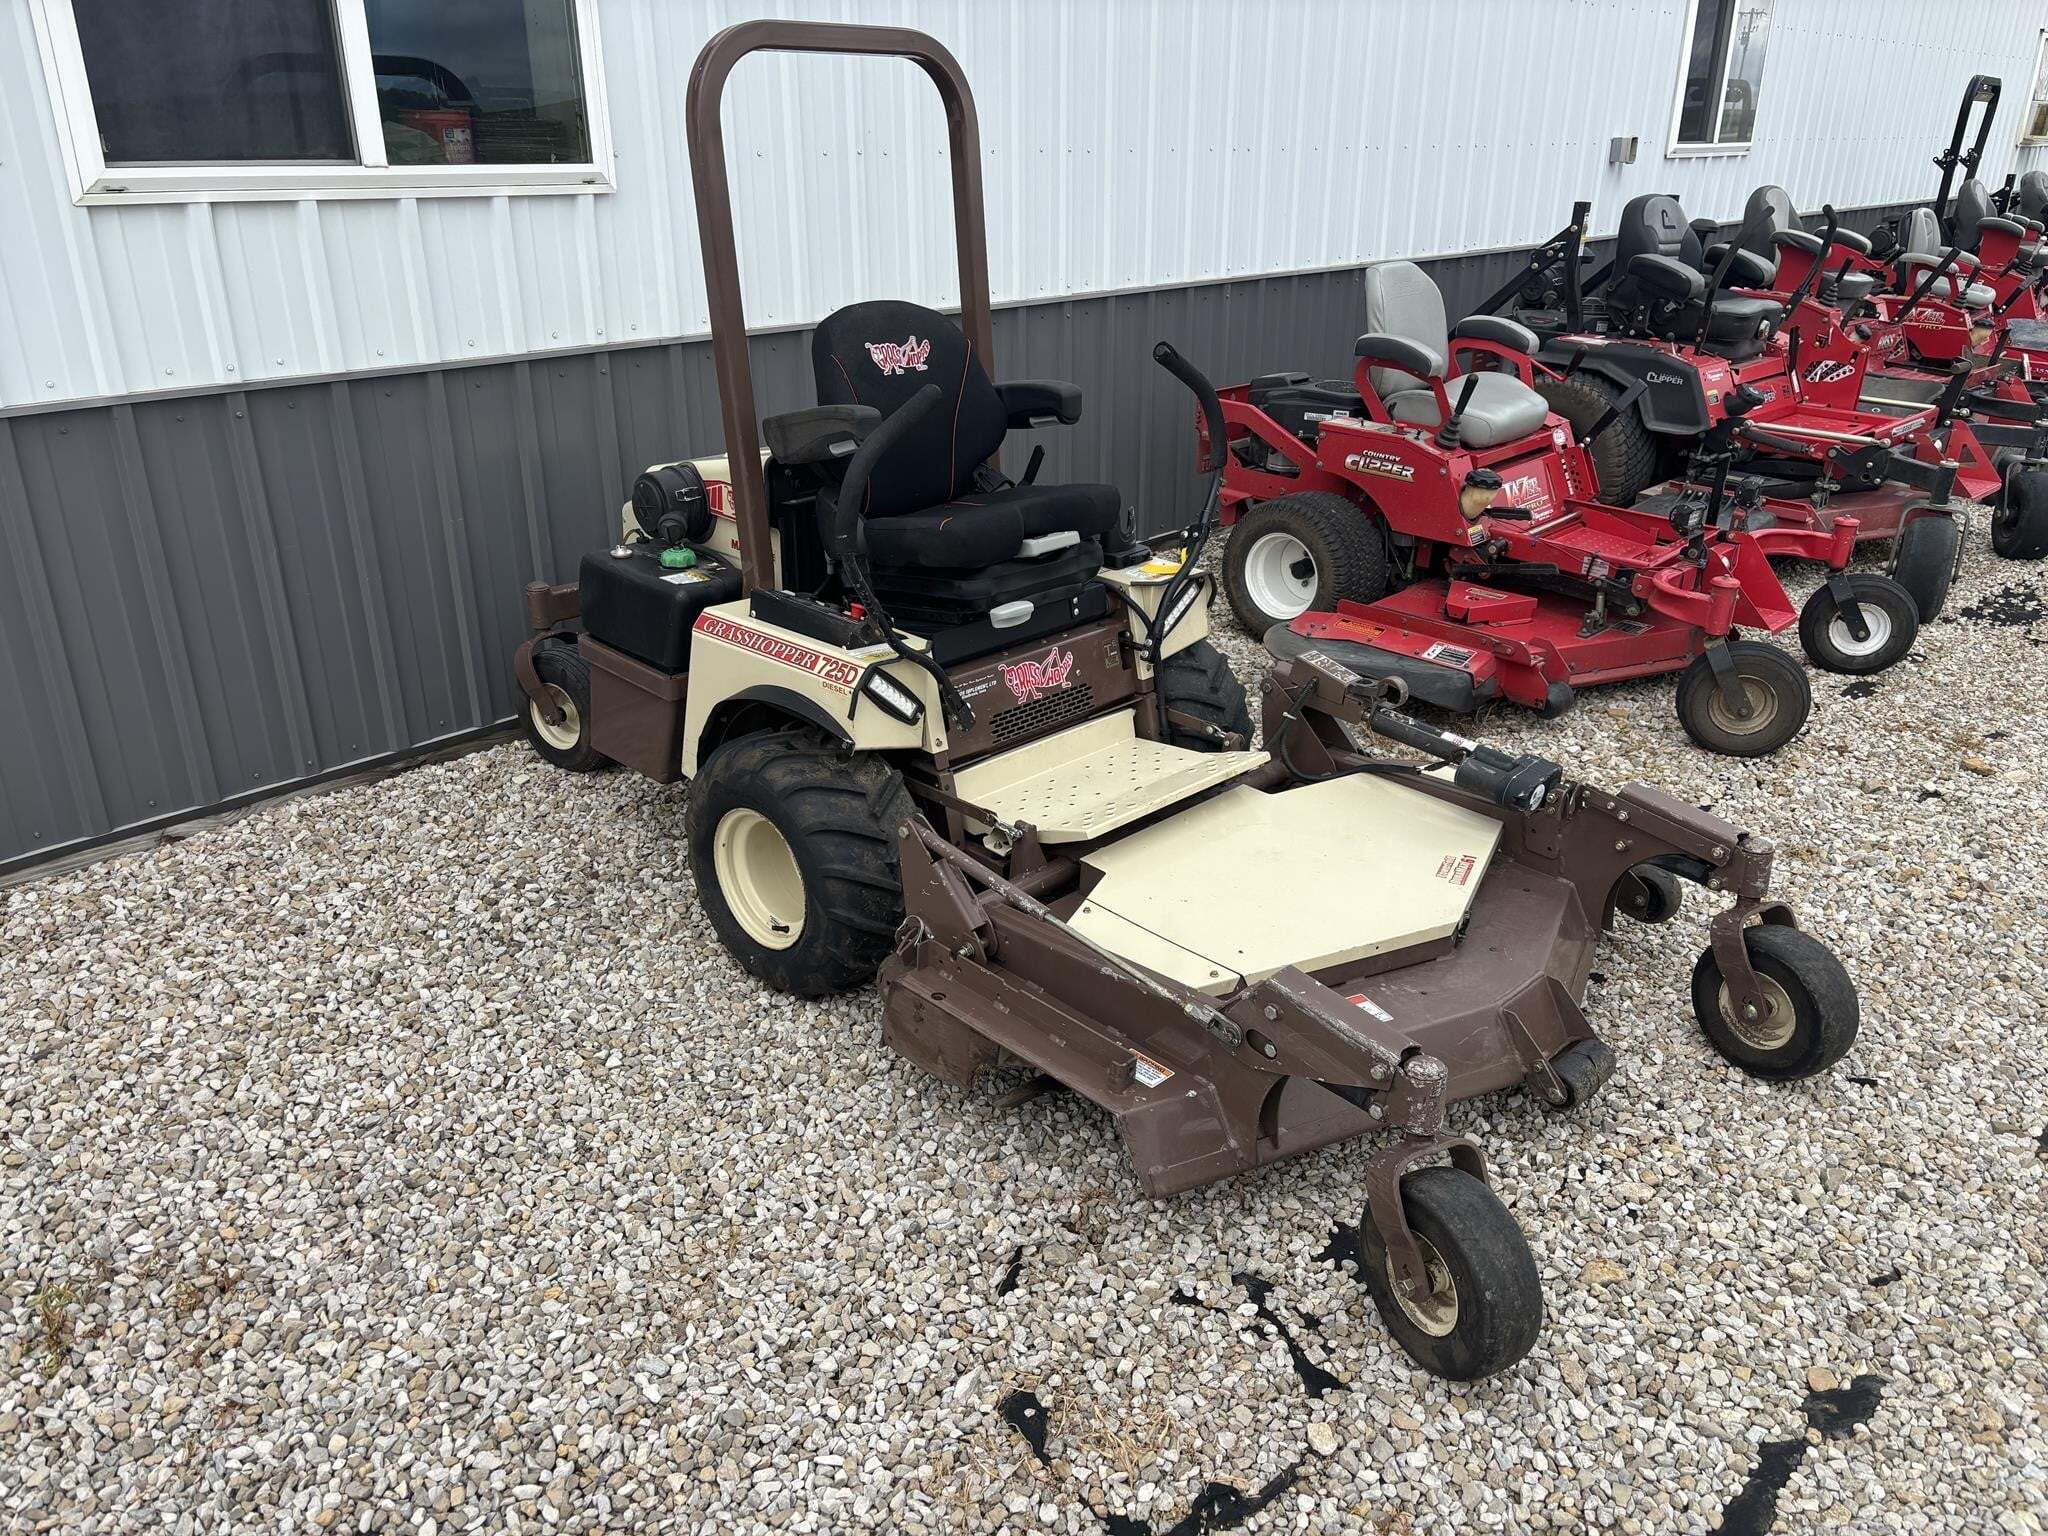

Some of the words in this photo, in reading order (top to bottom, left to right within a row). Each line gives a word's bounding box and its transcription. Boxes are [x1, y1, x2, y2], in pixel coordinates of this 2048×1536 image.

[1362, 449, 1402, 462] COUNTRY
[1344, 454, 1415, 482] CLIPPER
[703, 618, 817, 670] GRASSHOPPER
[817, 656, 859, 685] 725D
[822, 681, 848, 696] DIESEL
